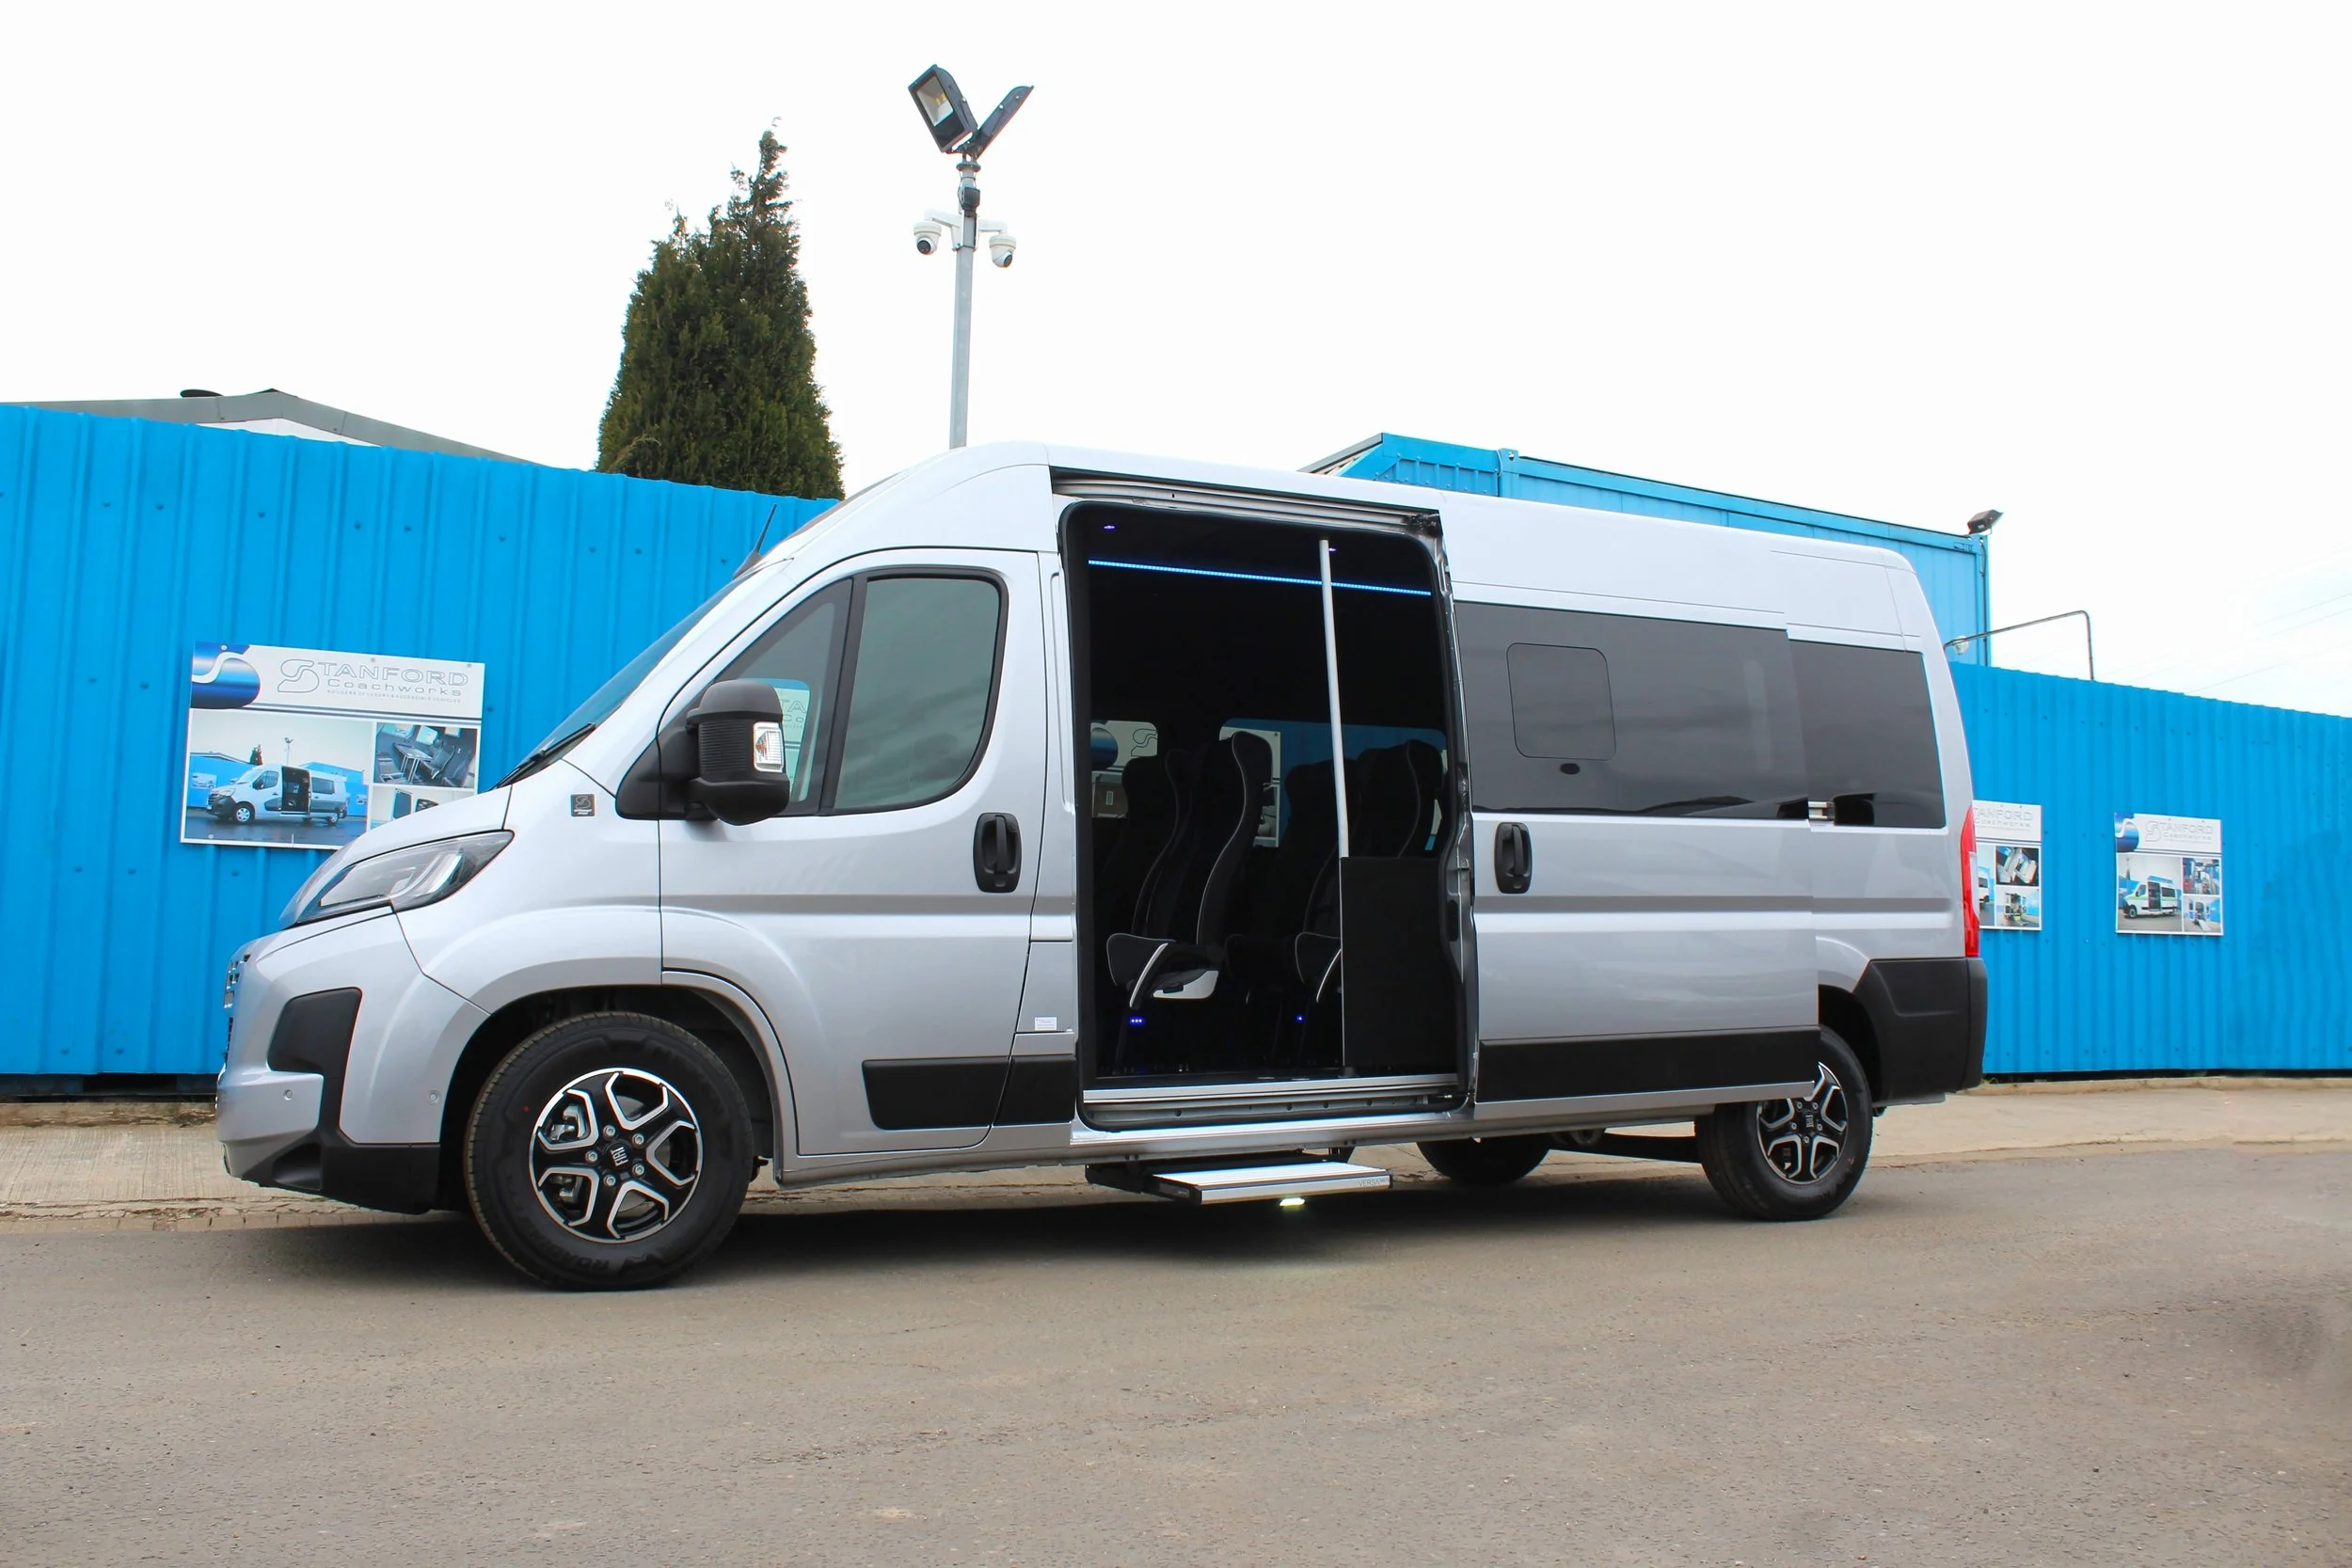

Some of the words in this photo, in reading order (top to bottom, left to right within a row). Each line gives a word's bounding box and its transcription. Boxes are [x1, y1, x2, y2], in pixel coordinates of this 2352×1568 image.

[278, 659, 469, 693] STANFORD
[327, 678, 462, 696] Coachworks
[1973, 807, 2034, 821] TANFORD
[611, 1147, 629, 1166] FIAT
